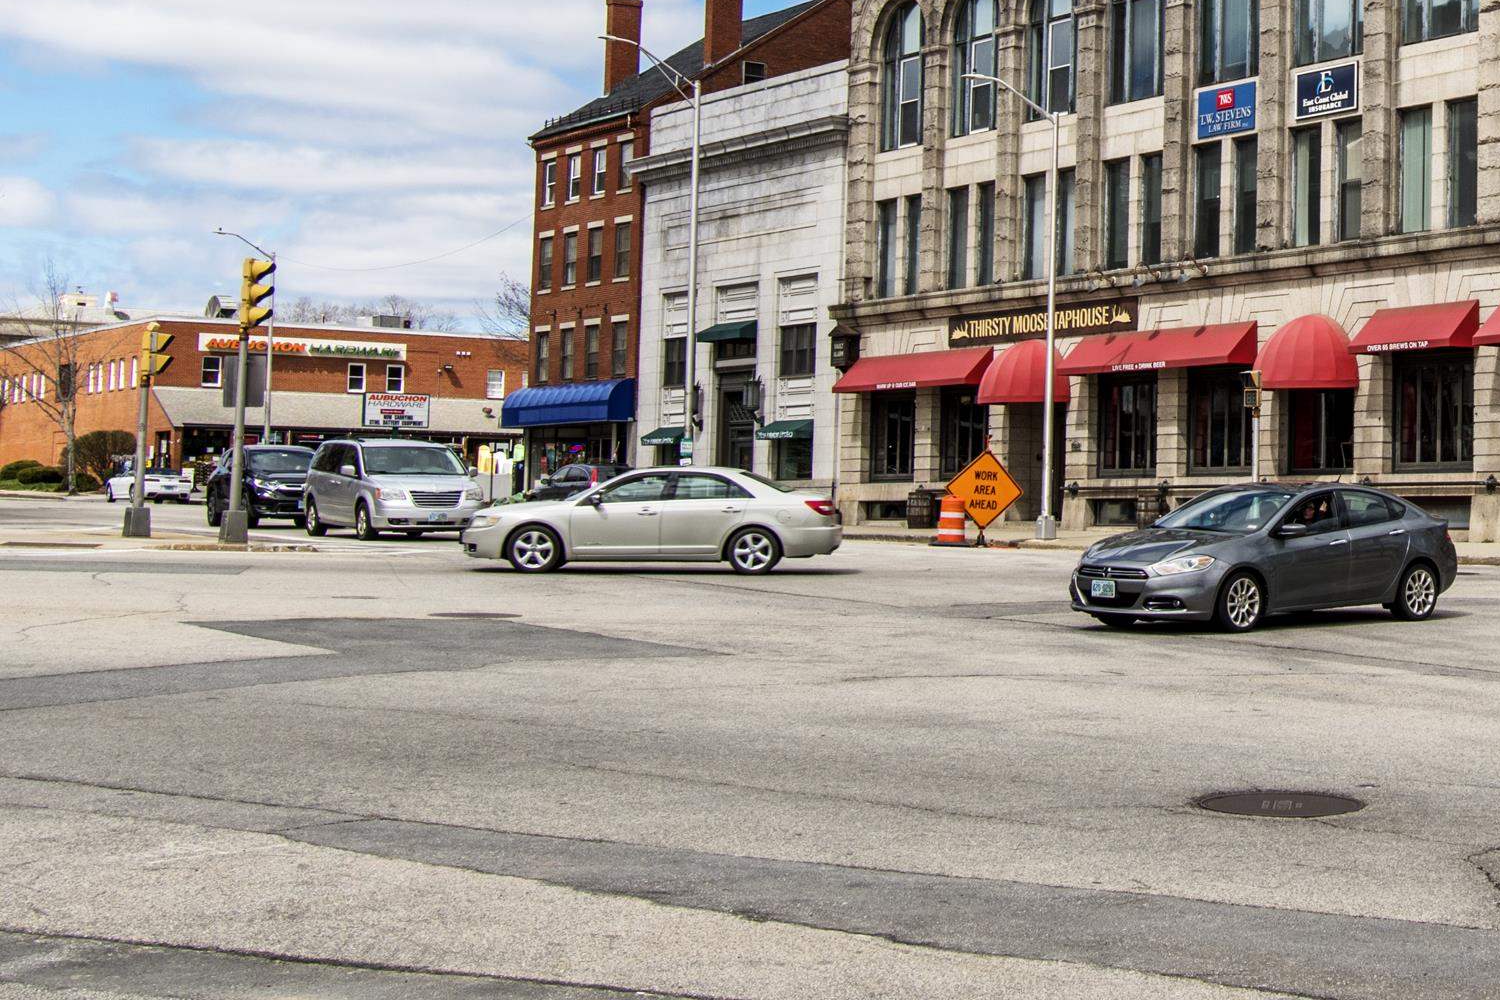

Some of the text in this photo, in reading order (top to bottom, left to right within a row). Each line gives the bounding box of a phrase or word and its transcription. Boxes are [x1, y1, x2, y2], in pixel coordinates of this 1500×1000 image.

[1314, 96, 1329, 104] Coast
[1330, 90, 1348, 101] Global
[1308, 101, 1342, 113] INSURANCE
[1215, 105, 1252, 122] STEVENS
[1208, 122, 1223, 133] LAW
[1224, 120, 1241, 130] FIRM
[969, 306, 1110, 338] THIRSTY MOOSE TAPHOUSE
[308, 343, 401, 358] HARDWARE
[1367, 344, 1381, 352] OVER
[1389, 342, 1408, 350] BREWS
[368, 394, 427, 402] AUBUCHON
[974, 470, 998, 481] WORK
[973, 485, 996, 495] AREA
[969, 499, 997, 510] AHEAD
